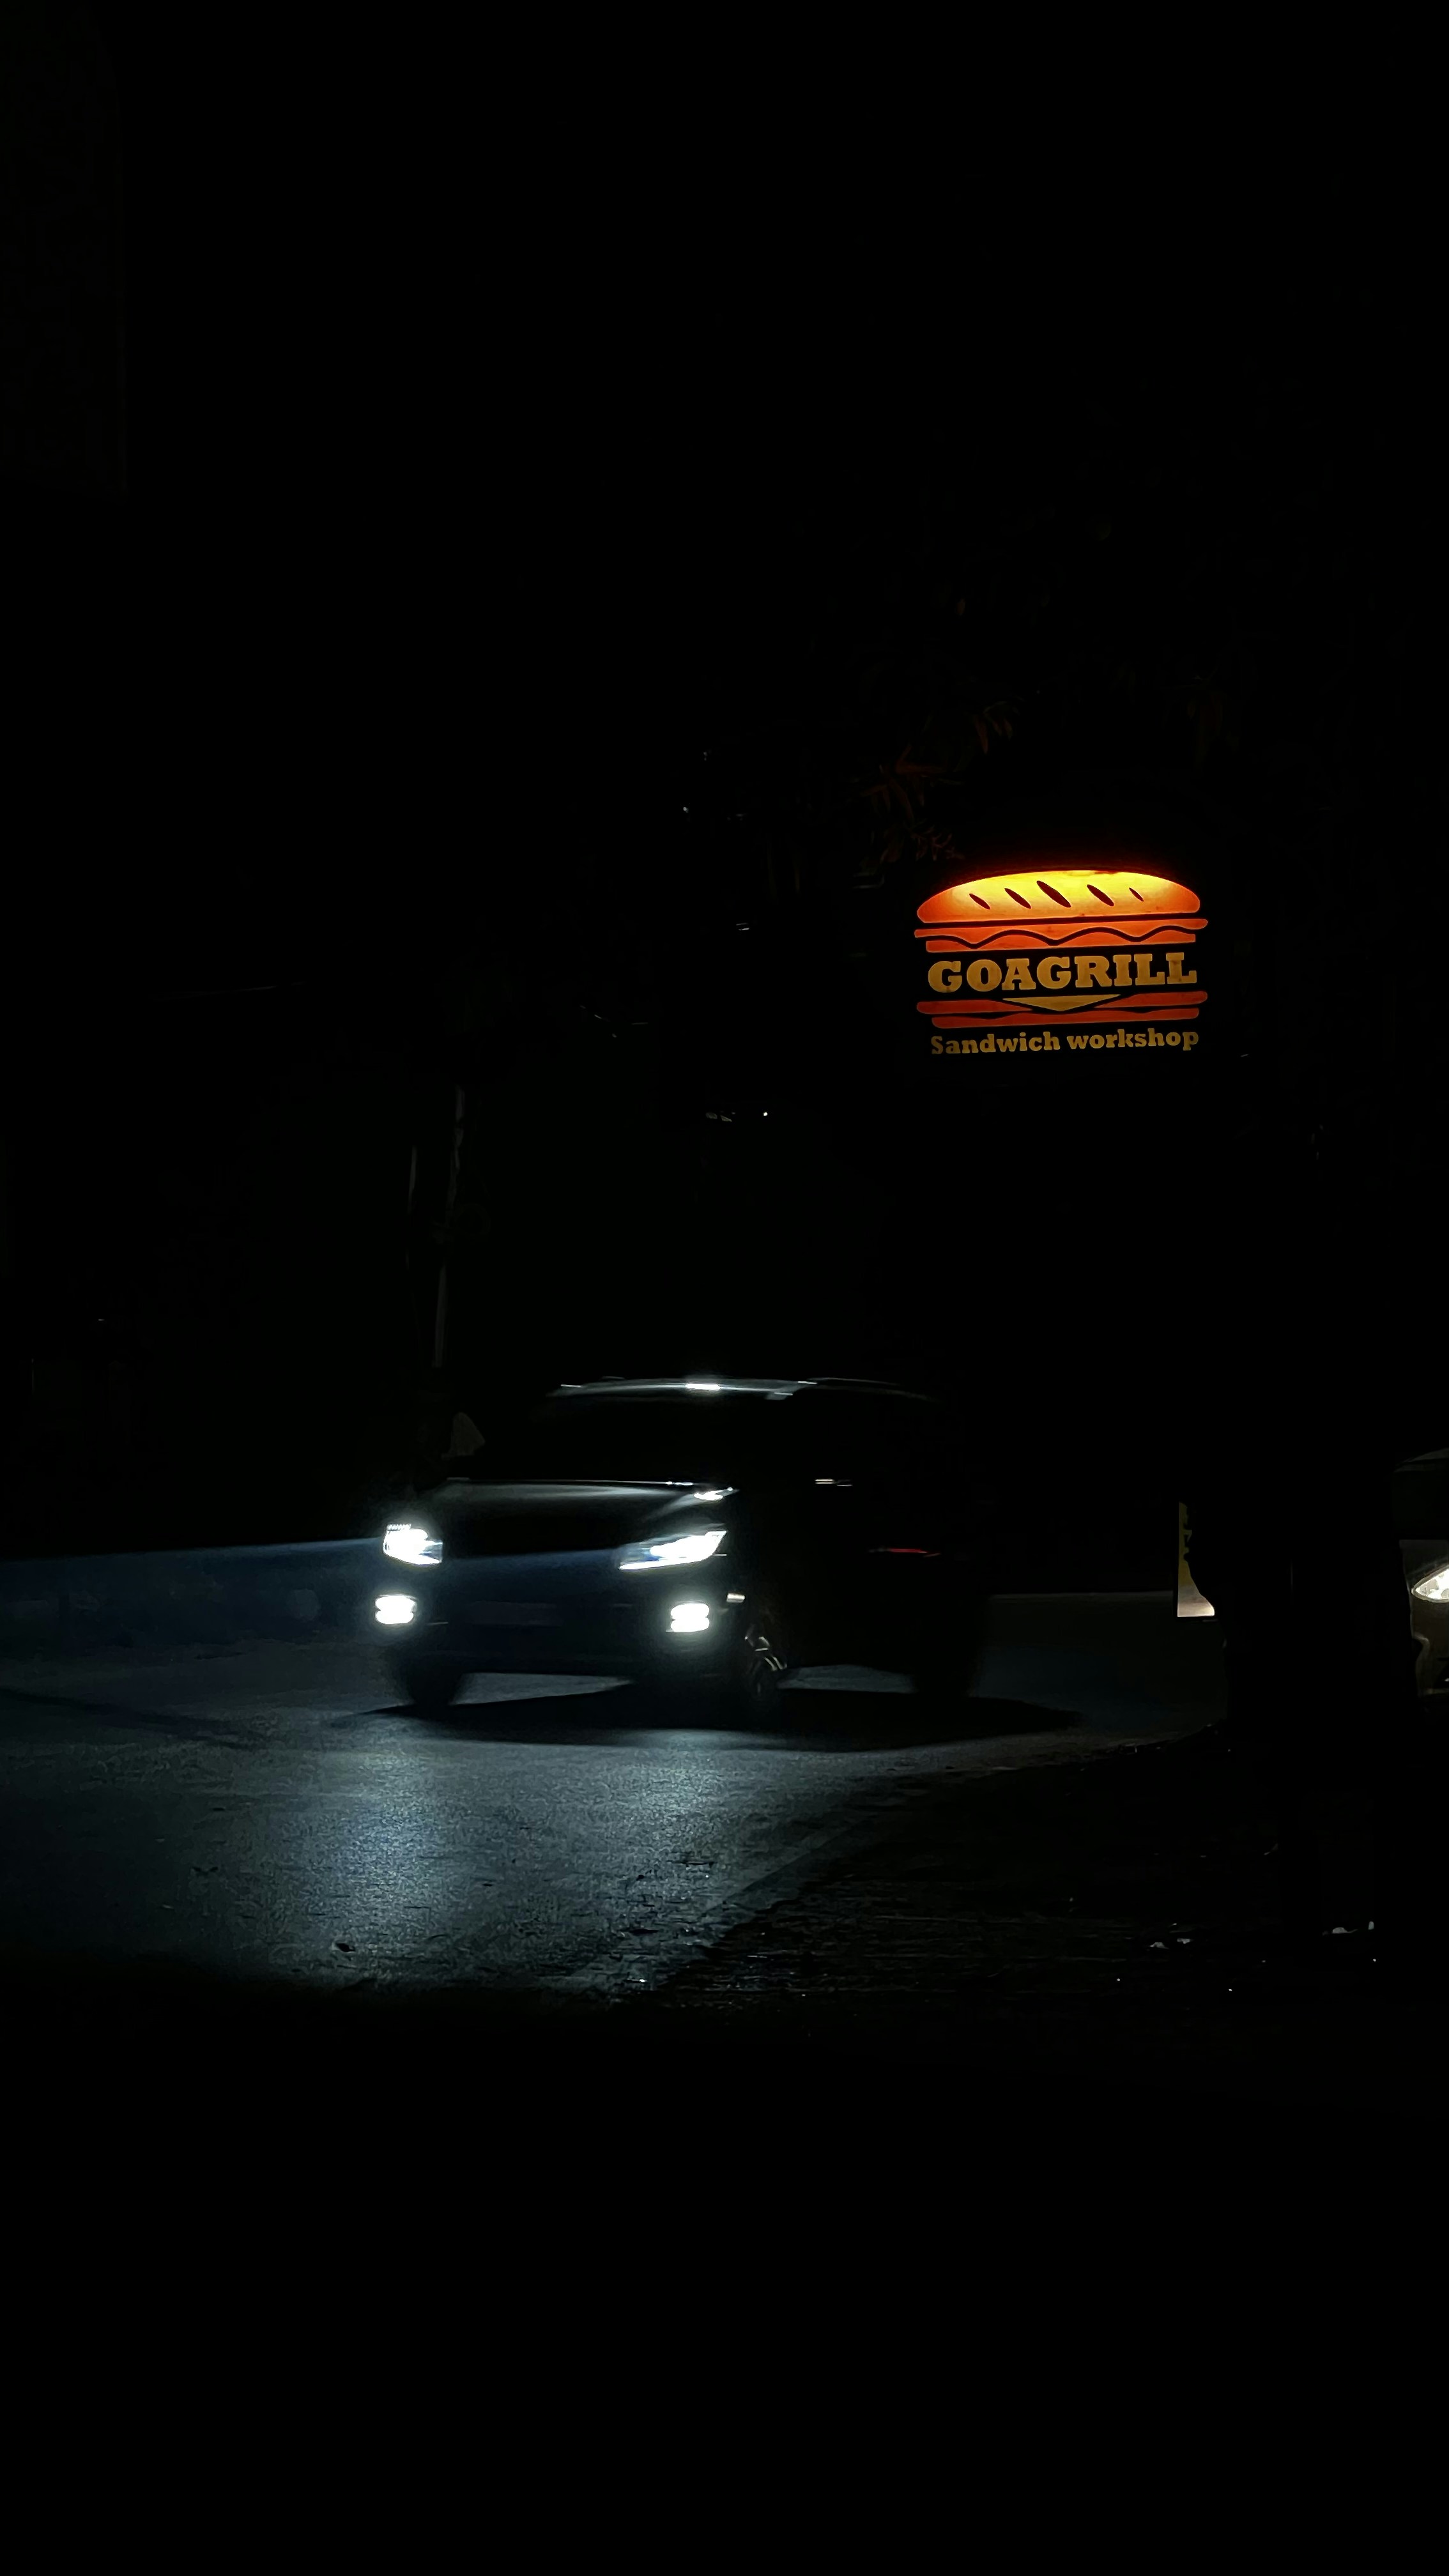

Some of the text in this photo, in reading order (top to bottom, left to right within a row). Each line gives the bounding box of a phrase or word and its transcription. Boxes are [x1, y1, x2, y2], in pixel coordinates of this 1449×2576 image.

[928, 952, 1197, 993] GOAGRILL
[931, 1028, 1199, 1055] Sandwich workshop
